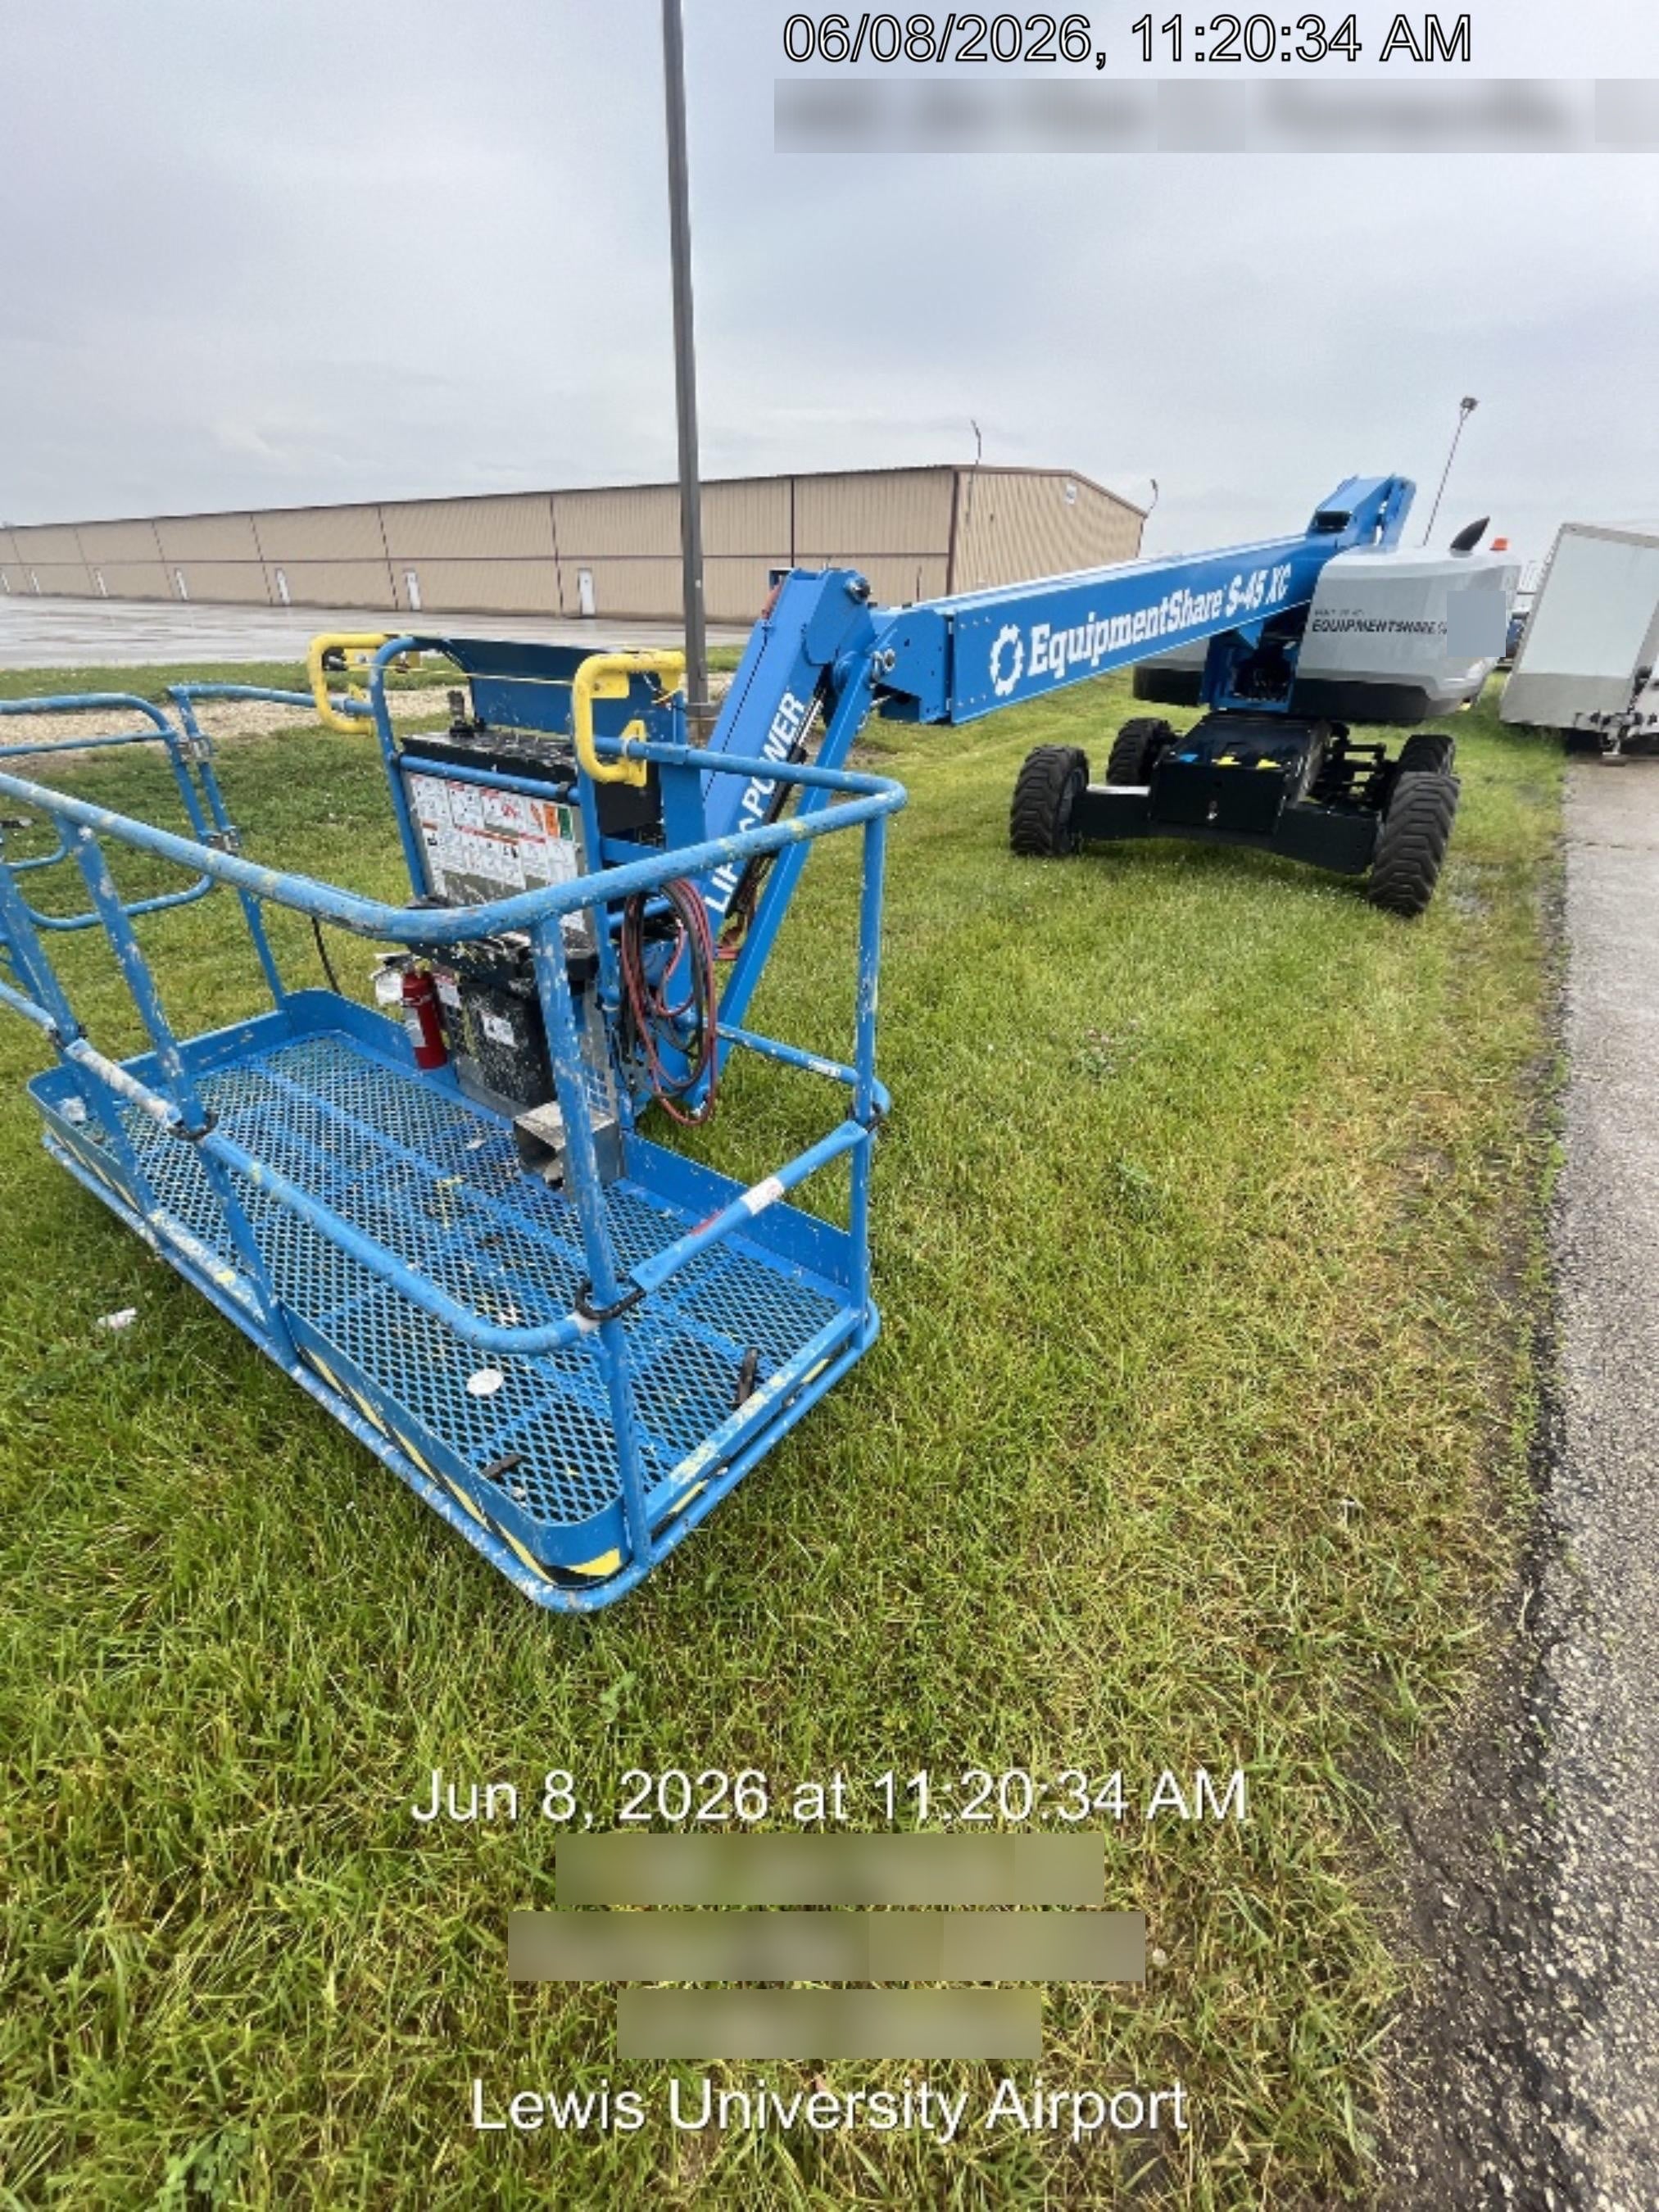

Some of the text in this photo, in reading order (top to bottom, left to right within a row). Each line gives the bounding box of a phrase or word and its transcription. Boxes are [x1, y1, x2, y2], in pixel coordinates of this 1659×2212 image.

[1027, 562, 1292, 679] EquipmentShare S-45 XC
[703, 852, 741, 913] LIF
